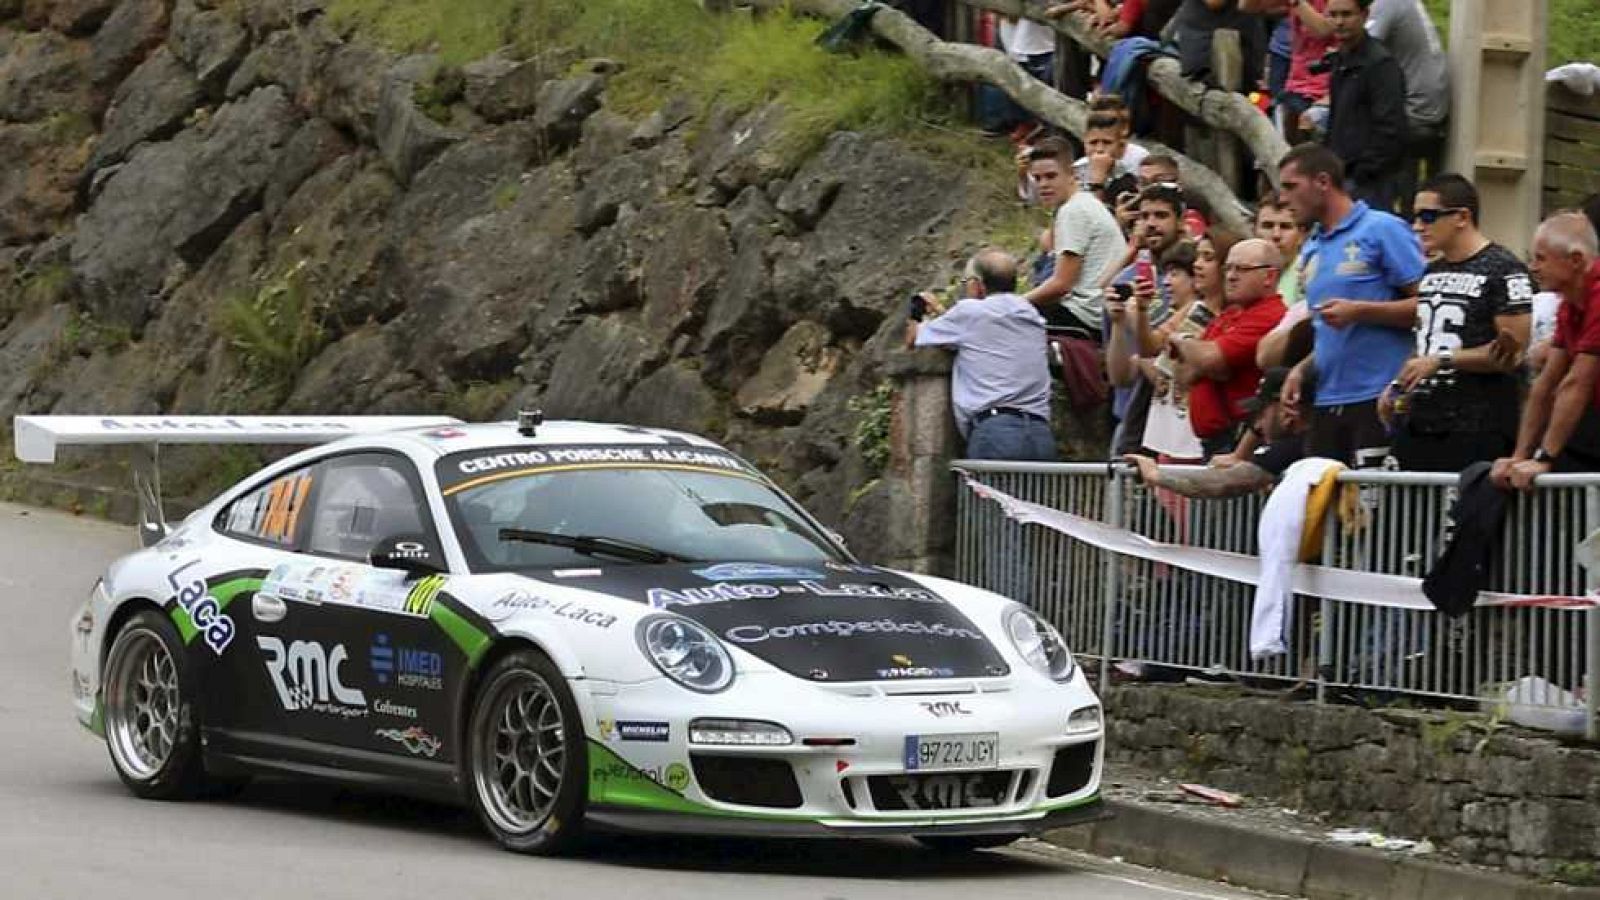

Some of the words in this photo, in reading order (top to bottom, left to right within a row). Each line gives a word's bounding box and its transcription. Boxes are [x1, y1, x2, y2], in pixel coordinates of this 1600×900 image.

[458, 452, 547, 473] CENTRO
[553, 449, 649, 463] PORSCHE
[651, 449, 746, 471] ALICANTE
[494, 591, 618, 628] Auto-Laca
[725, 617, 982, 643] Competición
[256, 635, 367, 710] RMC
[398, 648, 442, 674] IMED
[622, 726, 668, 736] MICHELIN
[919, 740, 964, 764] 9722
